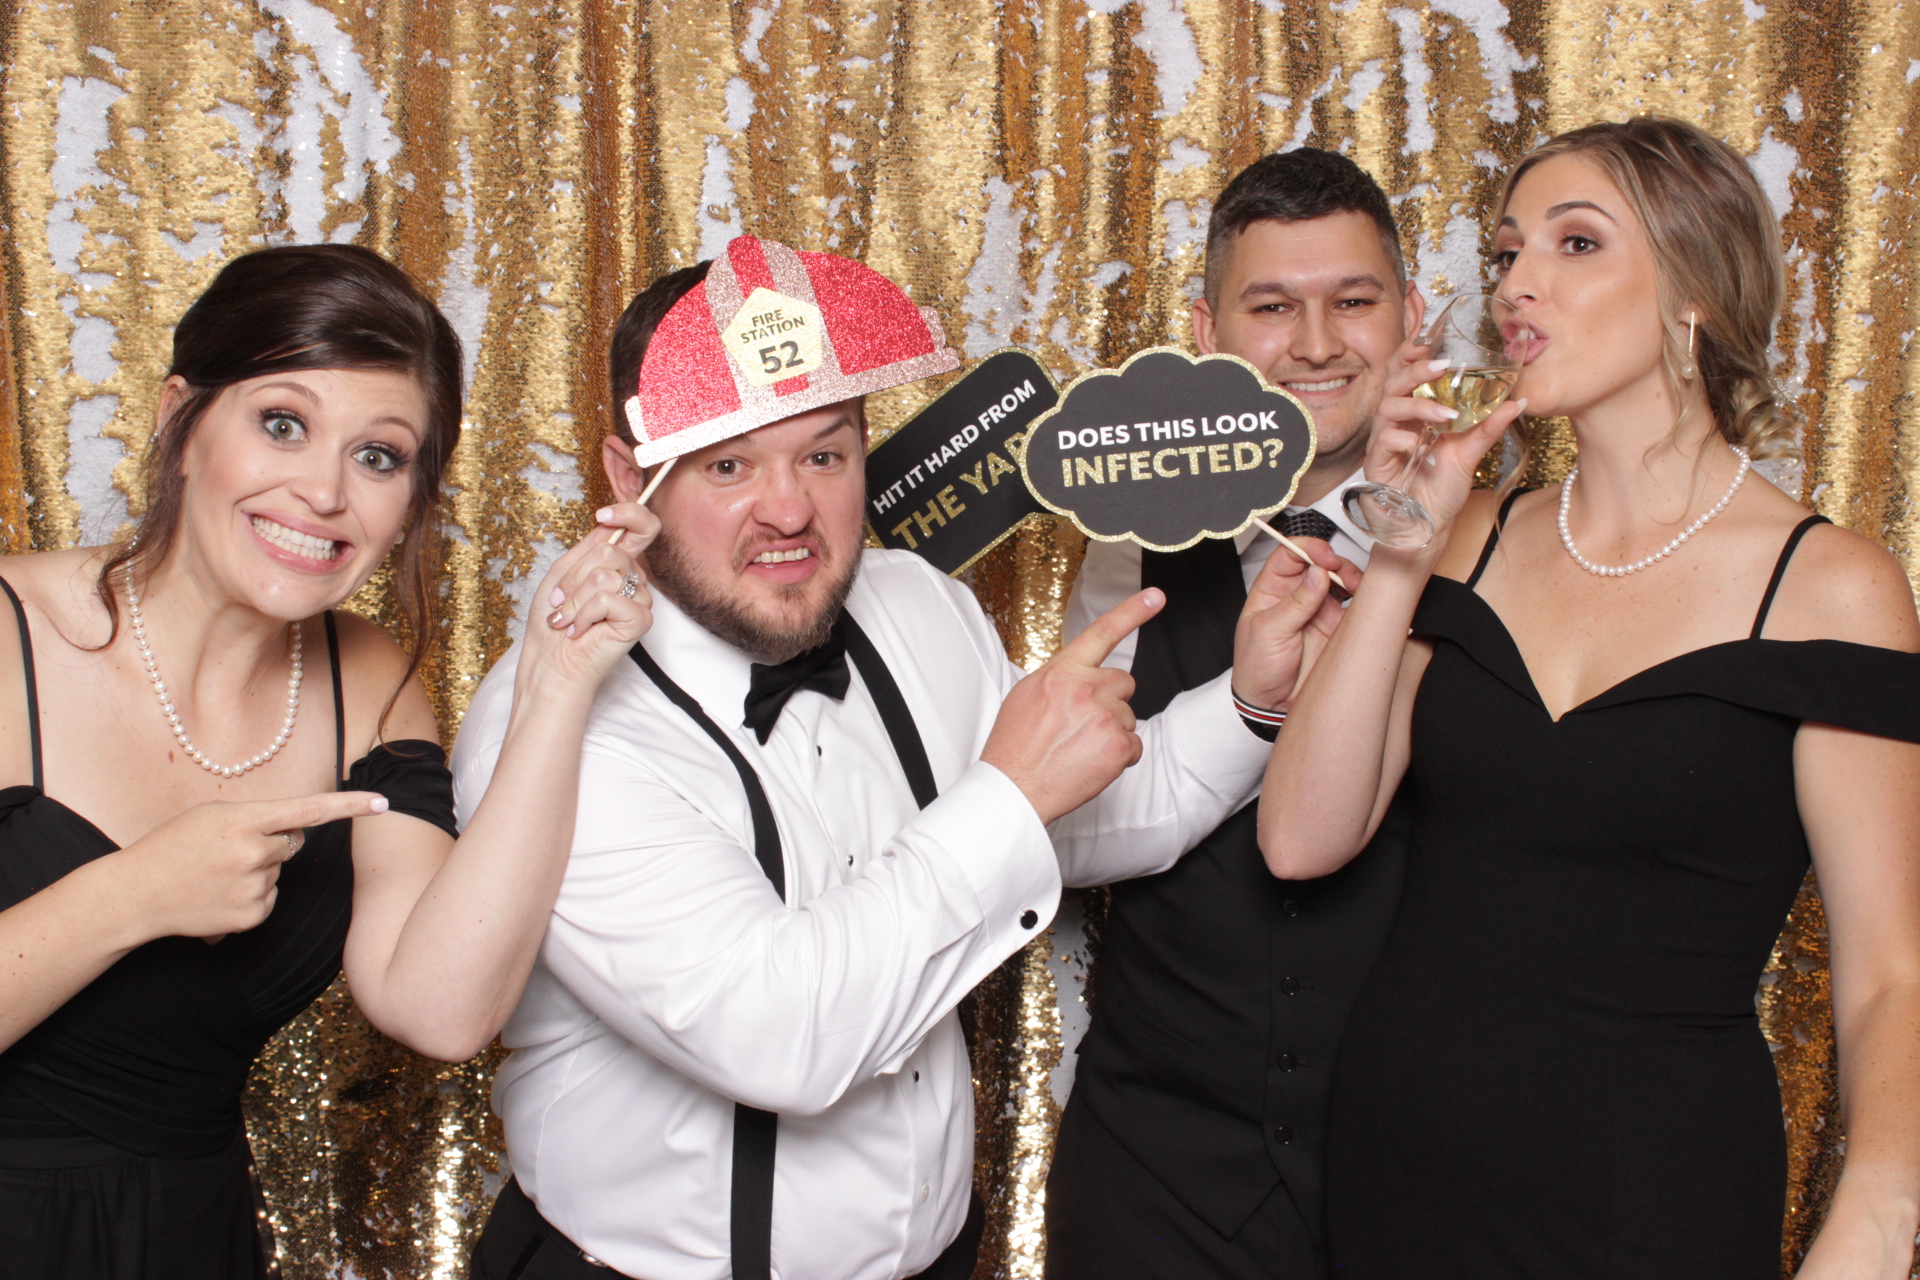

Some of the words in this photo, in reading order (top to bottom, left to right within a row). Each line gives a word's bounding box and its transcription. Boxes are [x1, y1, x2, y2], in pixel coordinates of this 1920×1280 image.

[741, 316, 805, 343] STATION
[752, 309, 784, 327] FIRE
[759, 340, 804, 374] 52
[872, 480, 905, 514] HIT
[904, 464, 925, 489] IT
[924, 424, 979, 474] HARD
[978, 379, 1037, 431] FROM
[1058, 424, 1130, 450] DOES
[1134, 418, 1197, 442] THIS
[1201, 410, 1279, 436] LOOK
[1061, 437, 1284, 487] INFECTED?
[890, 484, 967, 550] THE
[959, 415, 1040, 495] YAR
